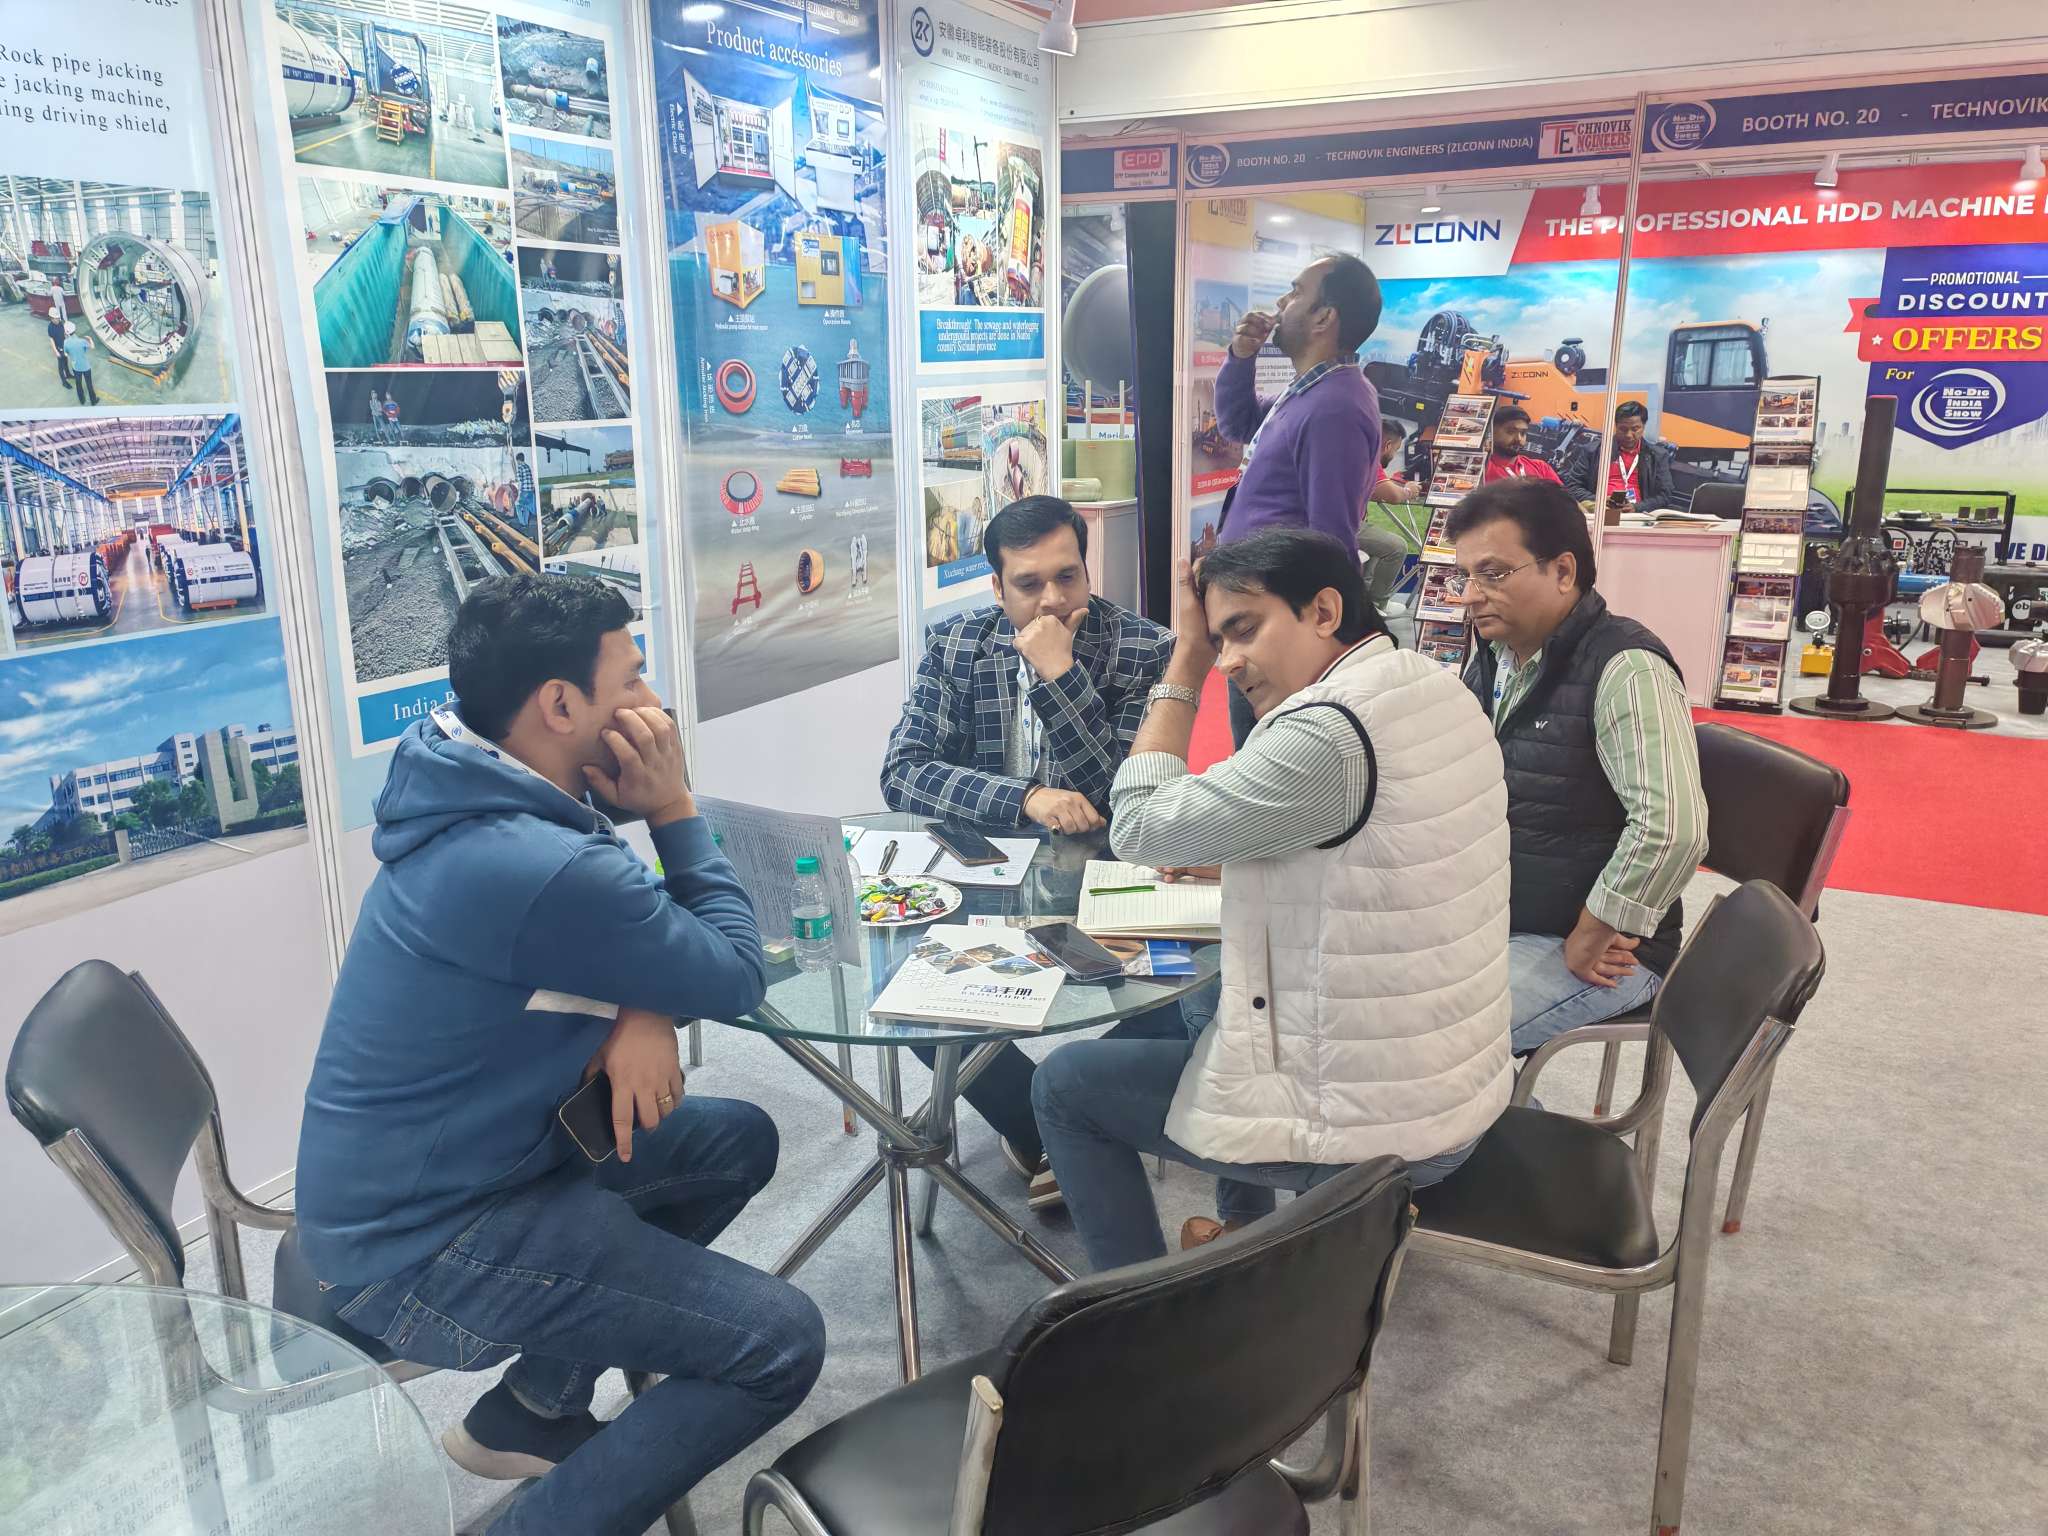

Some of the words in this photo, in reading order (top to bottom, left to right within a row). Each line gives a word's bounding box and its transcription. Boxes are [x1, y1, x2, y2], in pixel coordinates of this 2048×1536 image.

[914, 20, 930, 42] ZK
[706, 20, 765, 58] Product
[769, 43, 842, 78] accessories
[0, 44, 44, 66] Rock
[52, 53, 91, 75] pipe
[97, 58, 163, 87] jacking
[14, 74, 84, 102] jacking
[91, 87, 171, 112] machine,
[42, 104, 108, 132] driving
[116, 113, 168, 135] shield
[669, 103, 677, 130] Electric
[1742, 113, 1809, 132] BOOTH
[1815, 110, 1850, 128] NO.
[1856, 108, 1880, 124] 20
[1931, 97, 2048, 120] TECHNOVIK
[1237, 156, 1270, 167] BOOTH
[1273, 155, 1291, 164] NO.
[1294, 153, 1305, 163] 20
[1327, 149, 1383, 161] TECHNOVIK
[1386, 144, 1444, 157] ENGINEERS
[1447, 139, 1495, 156] (ZLCONN
[1497, 137, 1534, 151] INDIA)
[1545, 217, 1593, 237] THE
[1816, 202, 1882, 223] HDD
[1891, 194, 2036, 219] MACHINE
[1930, 271, 2020, 286] PROMOTIONAL
[1898, 292, 2048, 311] DISCOUNT
[1892, 326, 2043, 351] OFFERS
[1885, 368, 1915, 380] For
[1098, 431, 1130, 439] Maria
[393, 696, 438, 721] India
